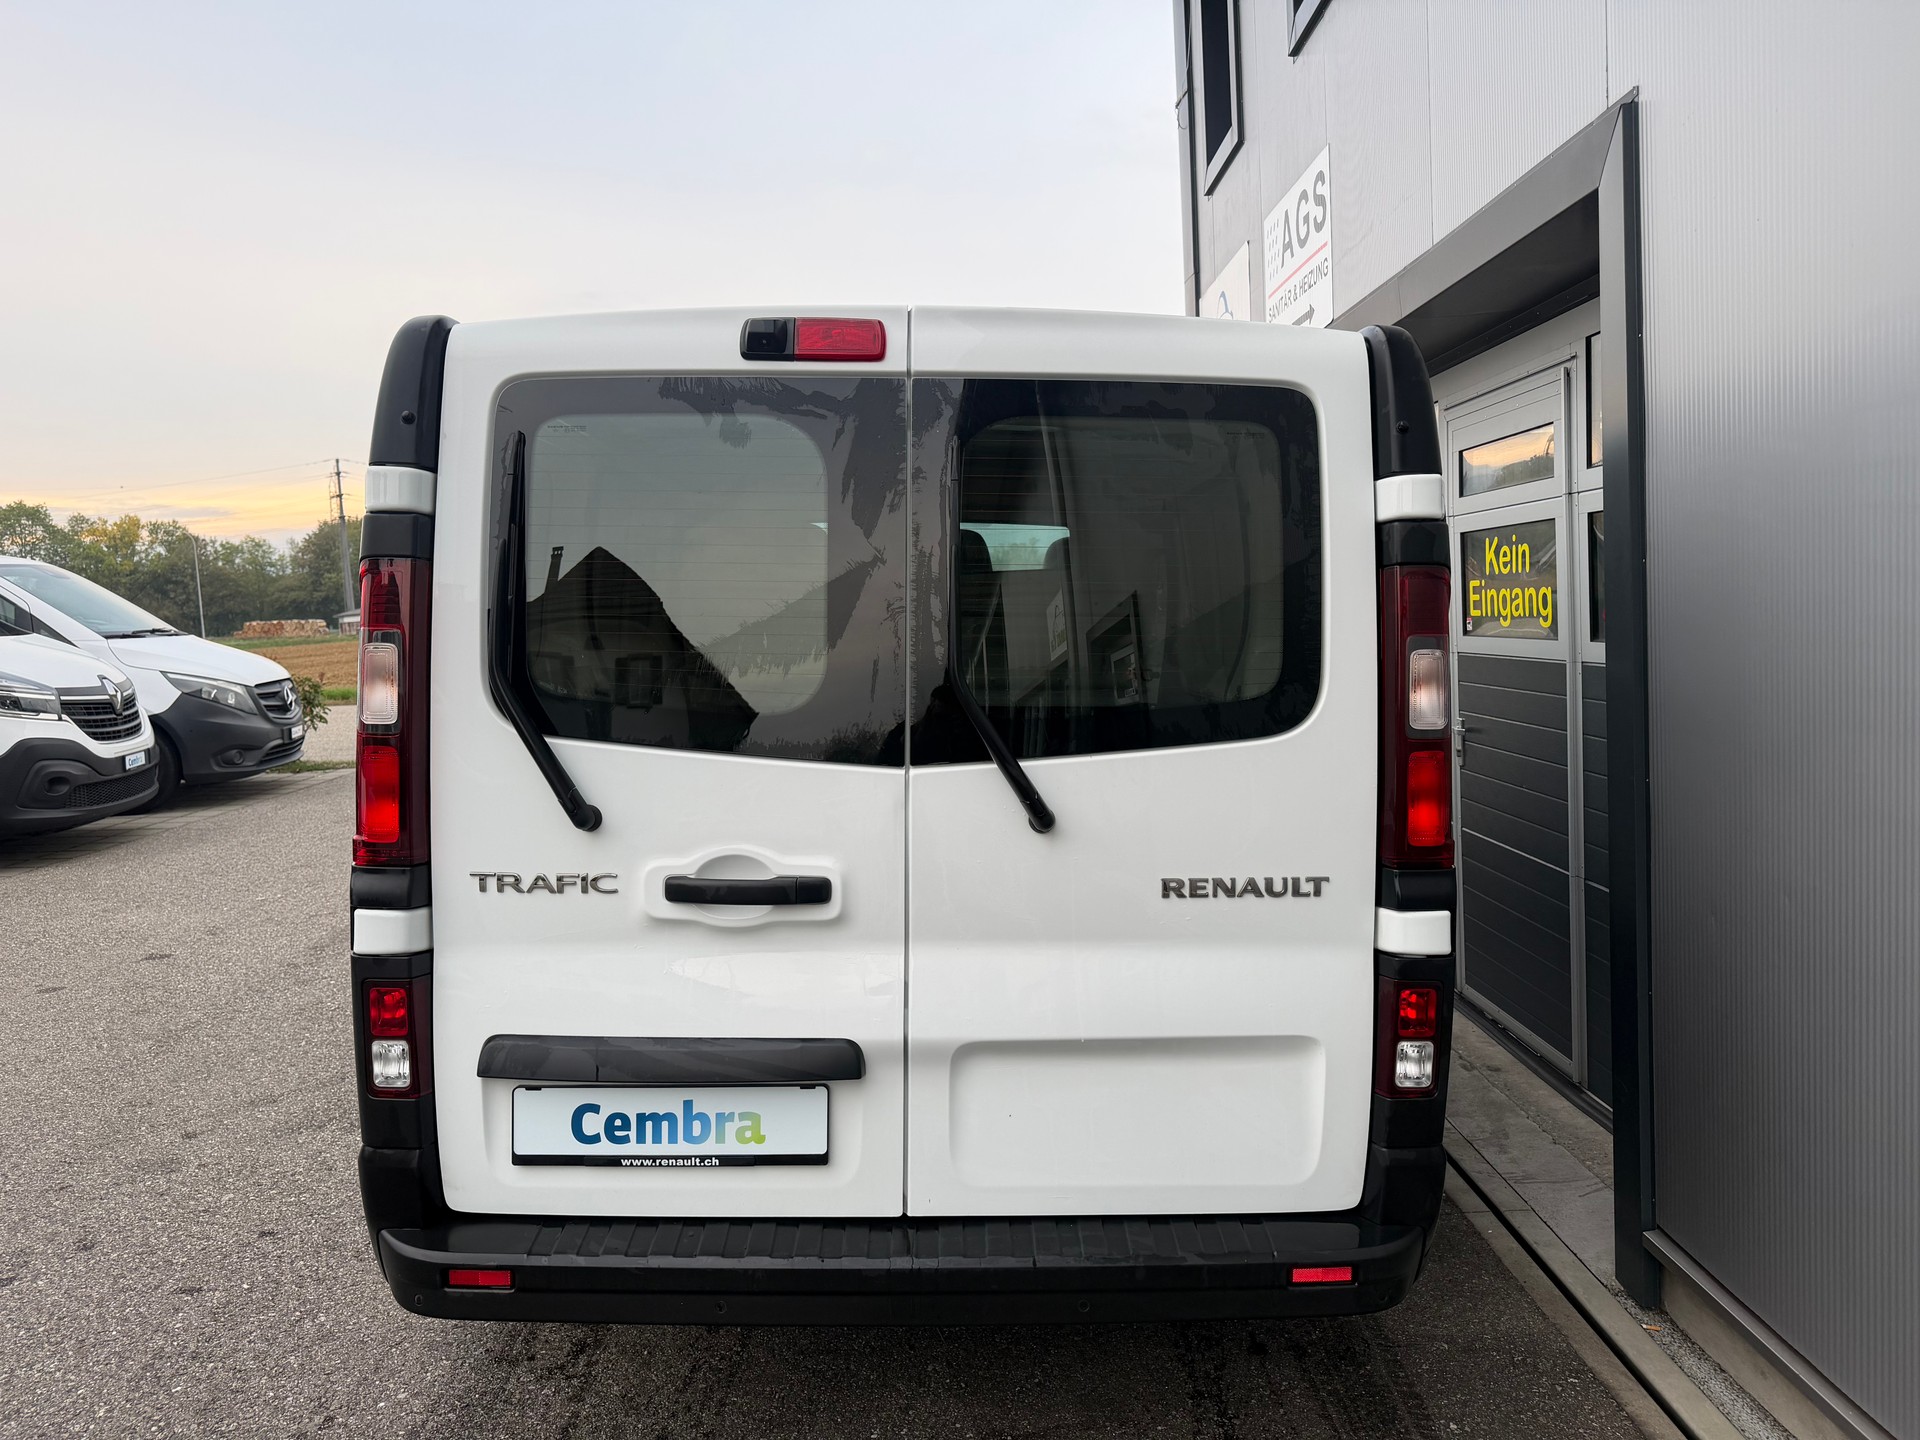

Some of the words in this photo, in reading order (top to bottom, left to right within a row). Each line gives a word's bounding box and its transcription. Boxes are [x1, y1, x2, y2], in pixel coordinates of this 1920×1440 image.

[1281, 169, 1328, 269] AGS
[1299, 257, 1329, 297] HEIZUNG
[1485, 534, 1530, 575] Kein
[1469, 579, 1553, 628] Eingang
[469, 871, 619, 894] TRAFIC
[1160, 876, 1330, 899] RENAULT
[570, 1099, 766, 1145] Cembra
[621, 1157, 719, 1167] www.renault.ch
